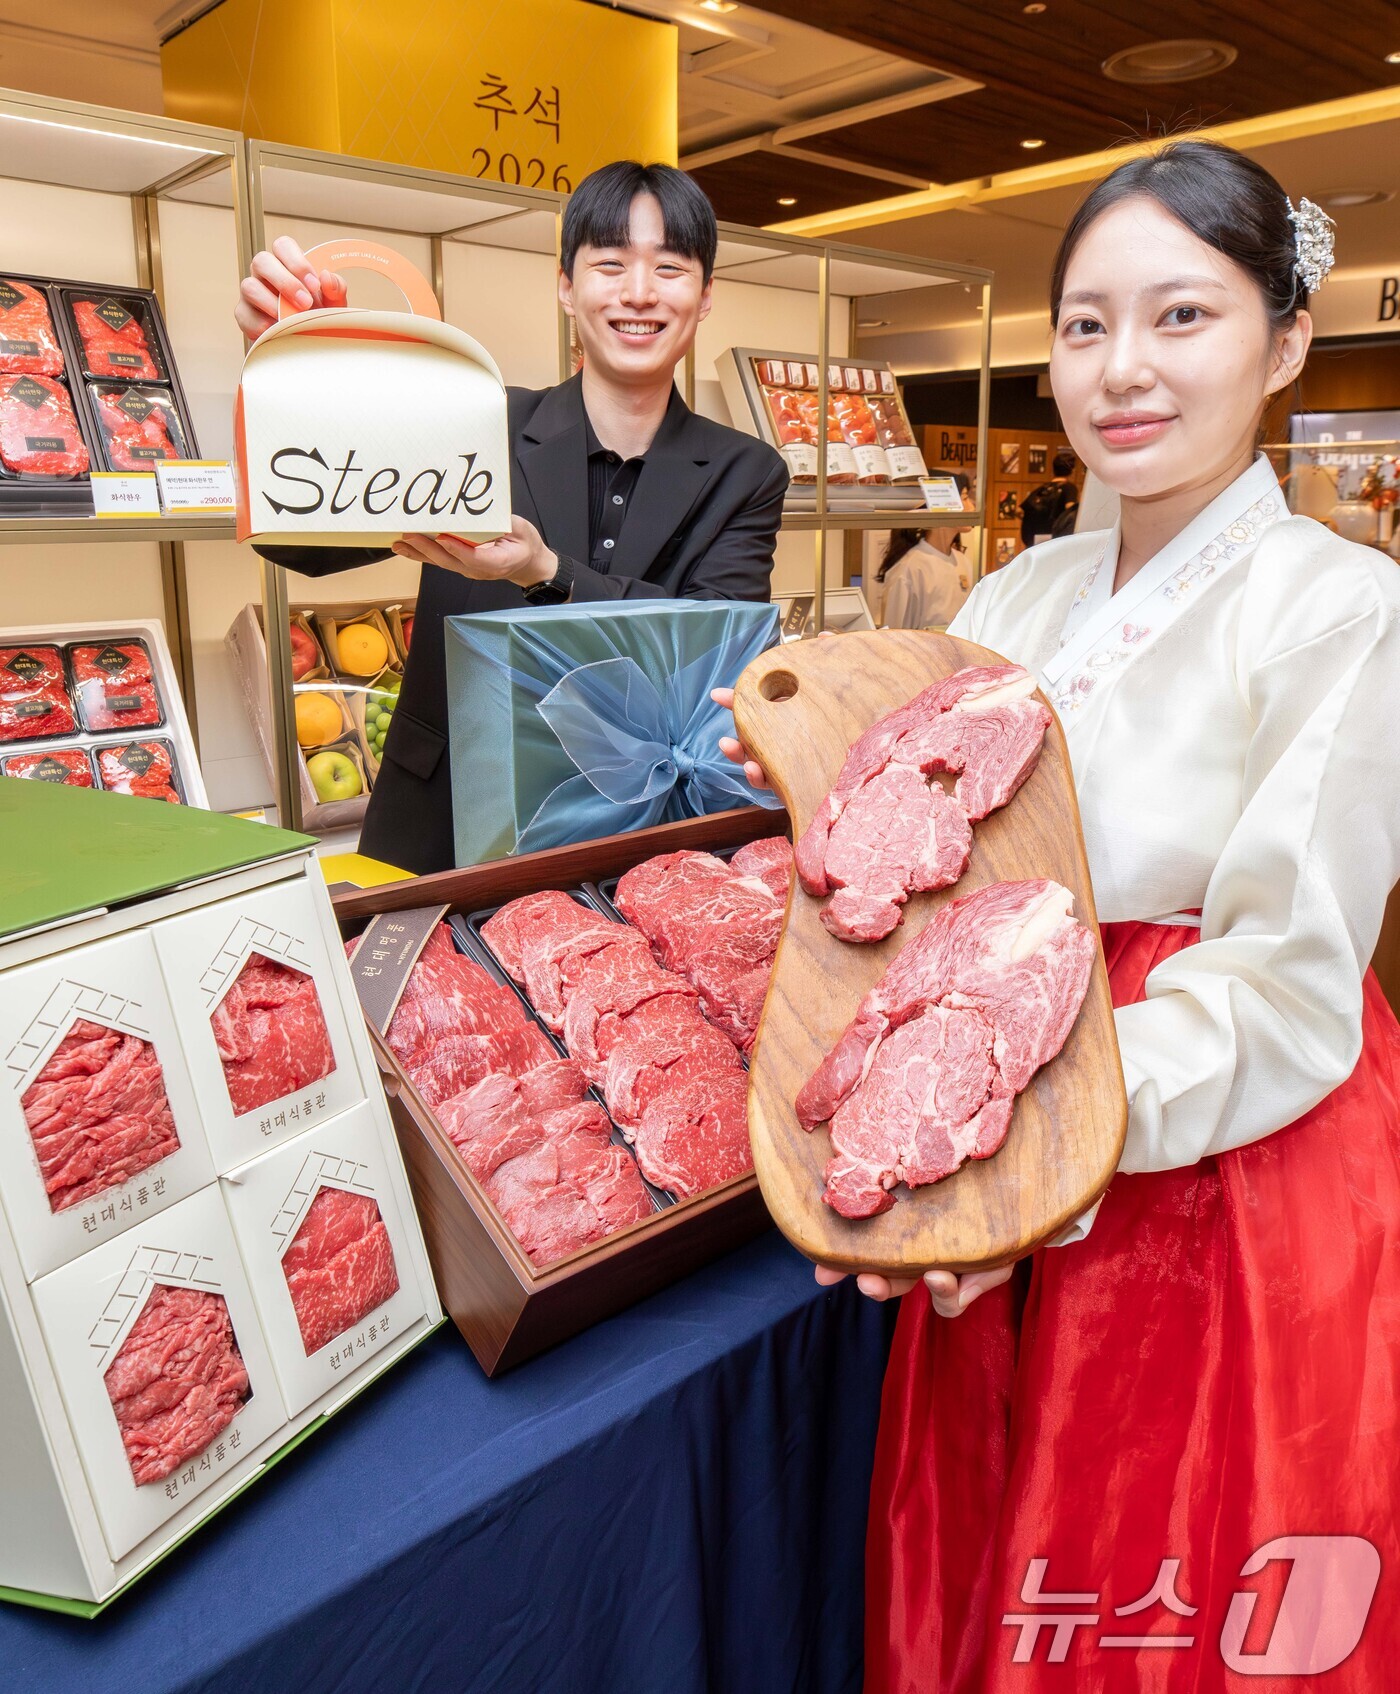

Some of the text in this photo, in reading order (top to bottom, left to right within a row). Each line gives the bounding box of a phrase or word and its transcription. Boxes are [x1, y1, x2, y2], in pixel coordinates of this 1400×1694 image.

[473, 72, 559, 144] 추석
[472, 148, 571, 194] 2026
[1377, 277, 1400, 322] B
[941, 432, 978, 466] BEATLE
[111, 493, 141, 502] 화식한우
[262, 447, 494, 516] Steak
[361, 923, 406, 977] 현대명품
[259, 1091, 326, 1136] 현대식품관
[81, 1176, 166, 1234] 현대식품관
[329, 1314, 390, 1370] 현대식품관
[164, 1429, 241, 1500] 현대식품관
